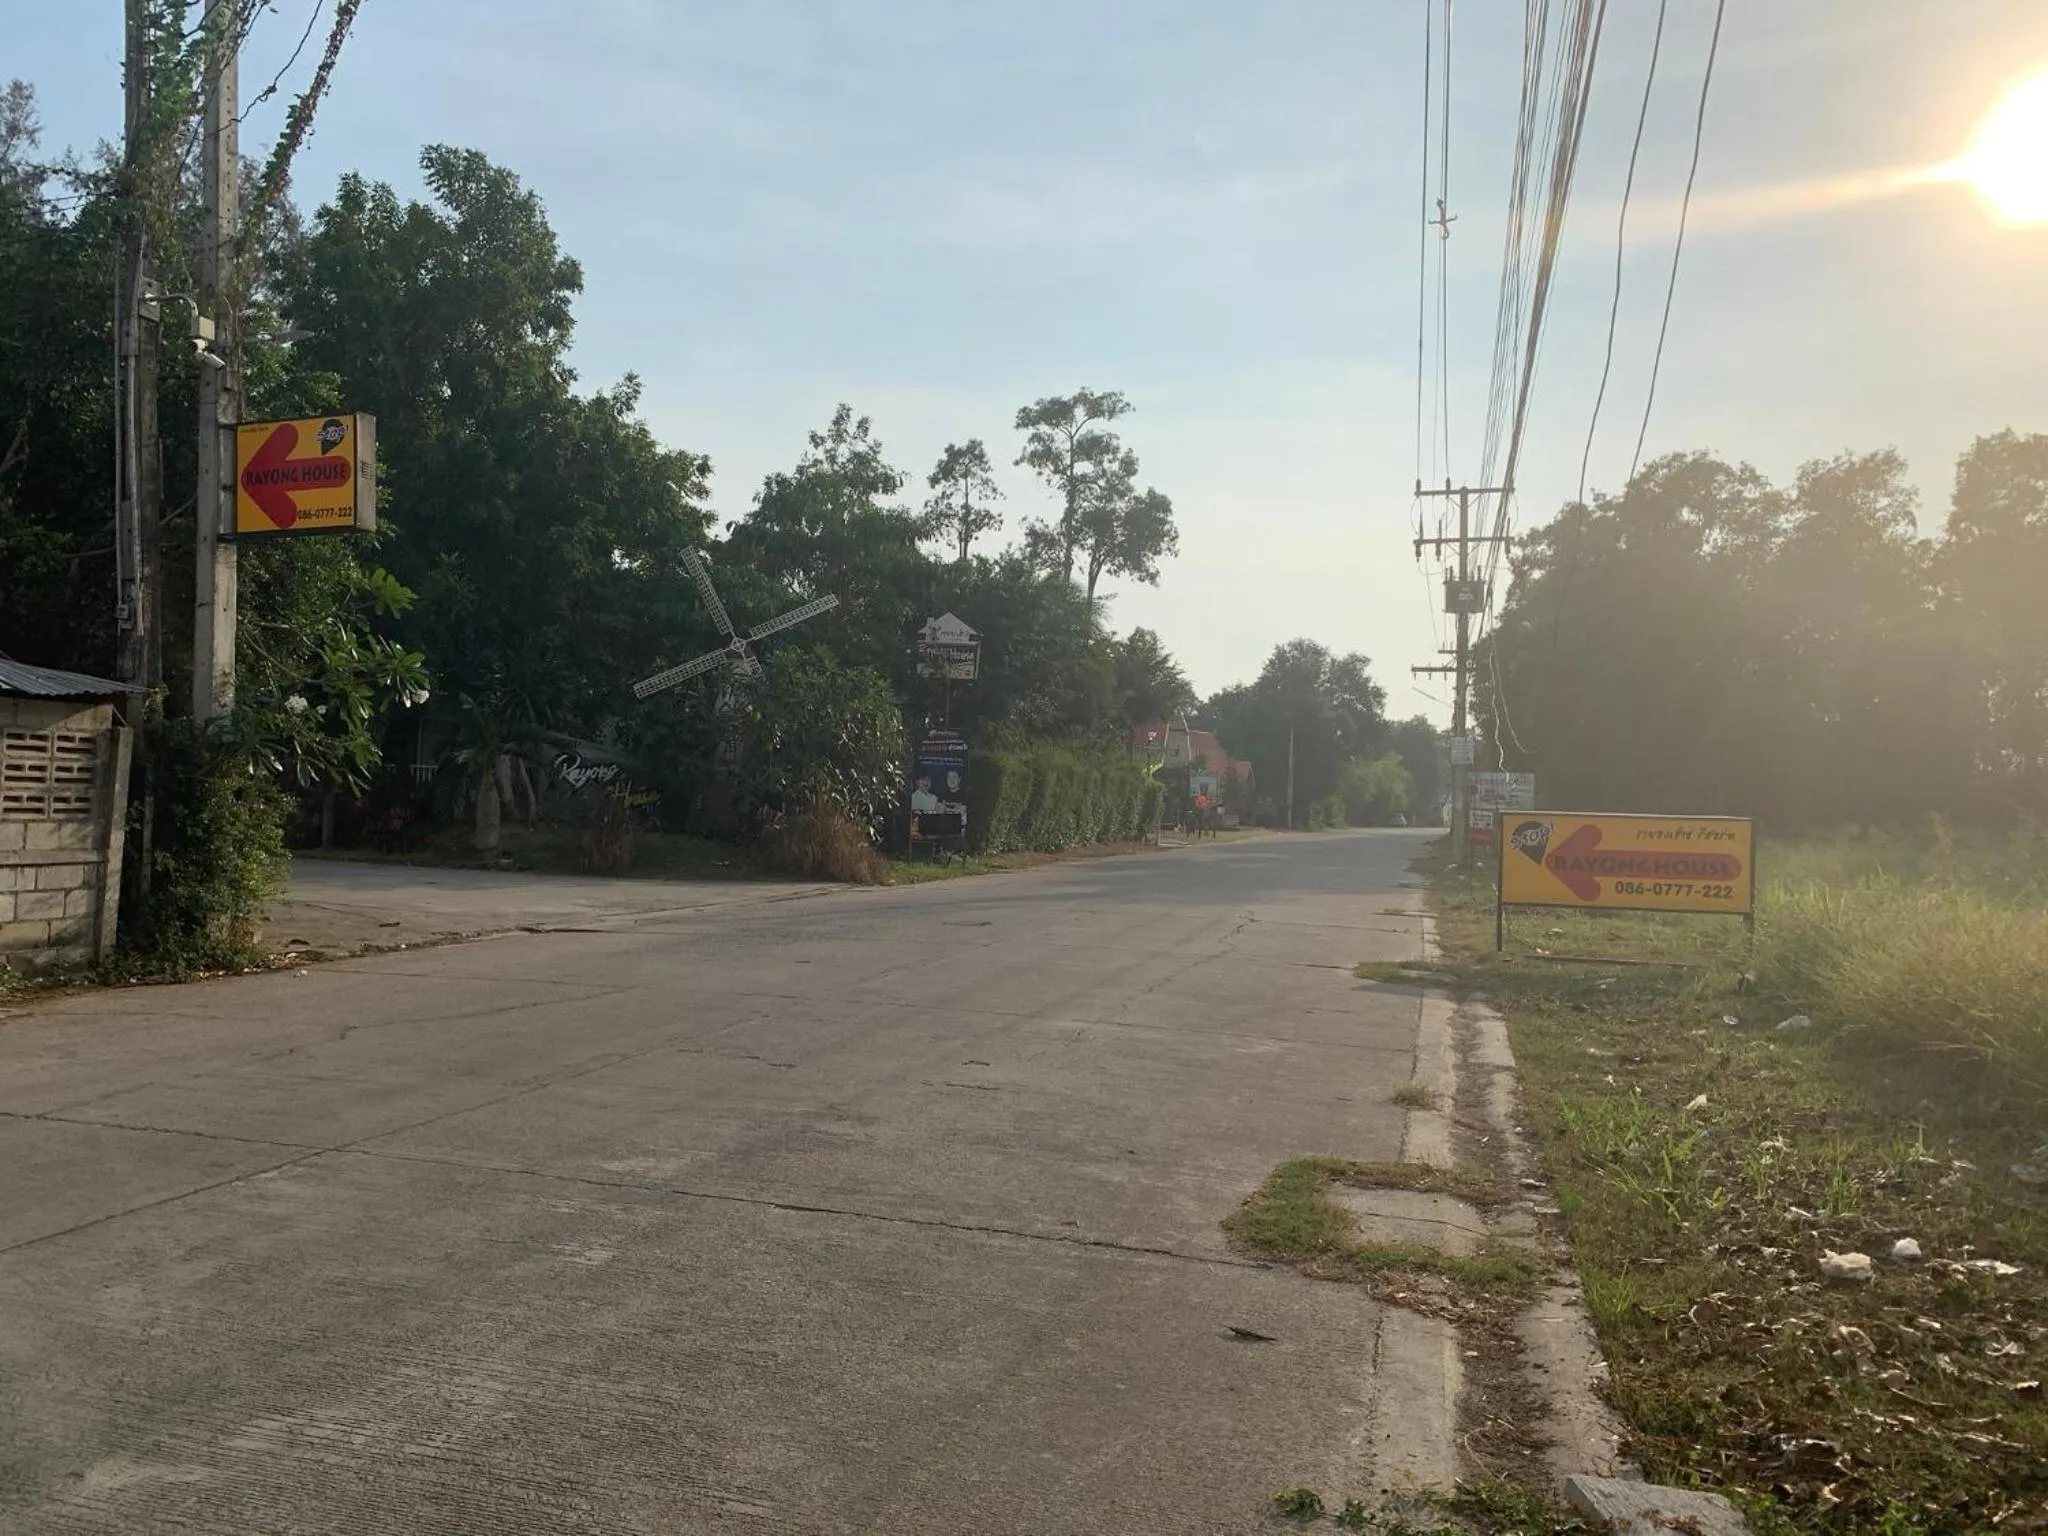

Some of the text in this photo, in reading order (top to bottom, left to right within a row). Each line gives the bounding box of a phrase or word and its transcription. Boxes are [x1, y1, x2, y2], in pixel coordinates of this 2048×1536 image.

[246, 463, 347, 486] RAYONG HOUSE
[298, 506, 353, 520] 086-0777-222
[554, 754, 619, 789] Rayong
[1554, 855, 1732, 878] RAYONG HOUSE
[1614, 881, 1733, 899] 086-0777-222
